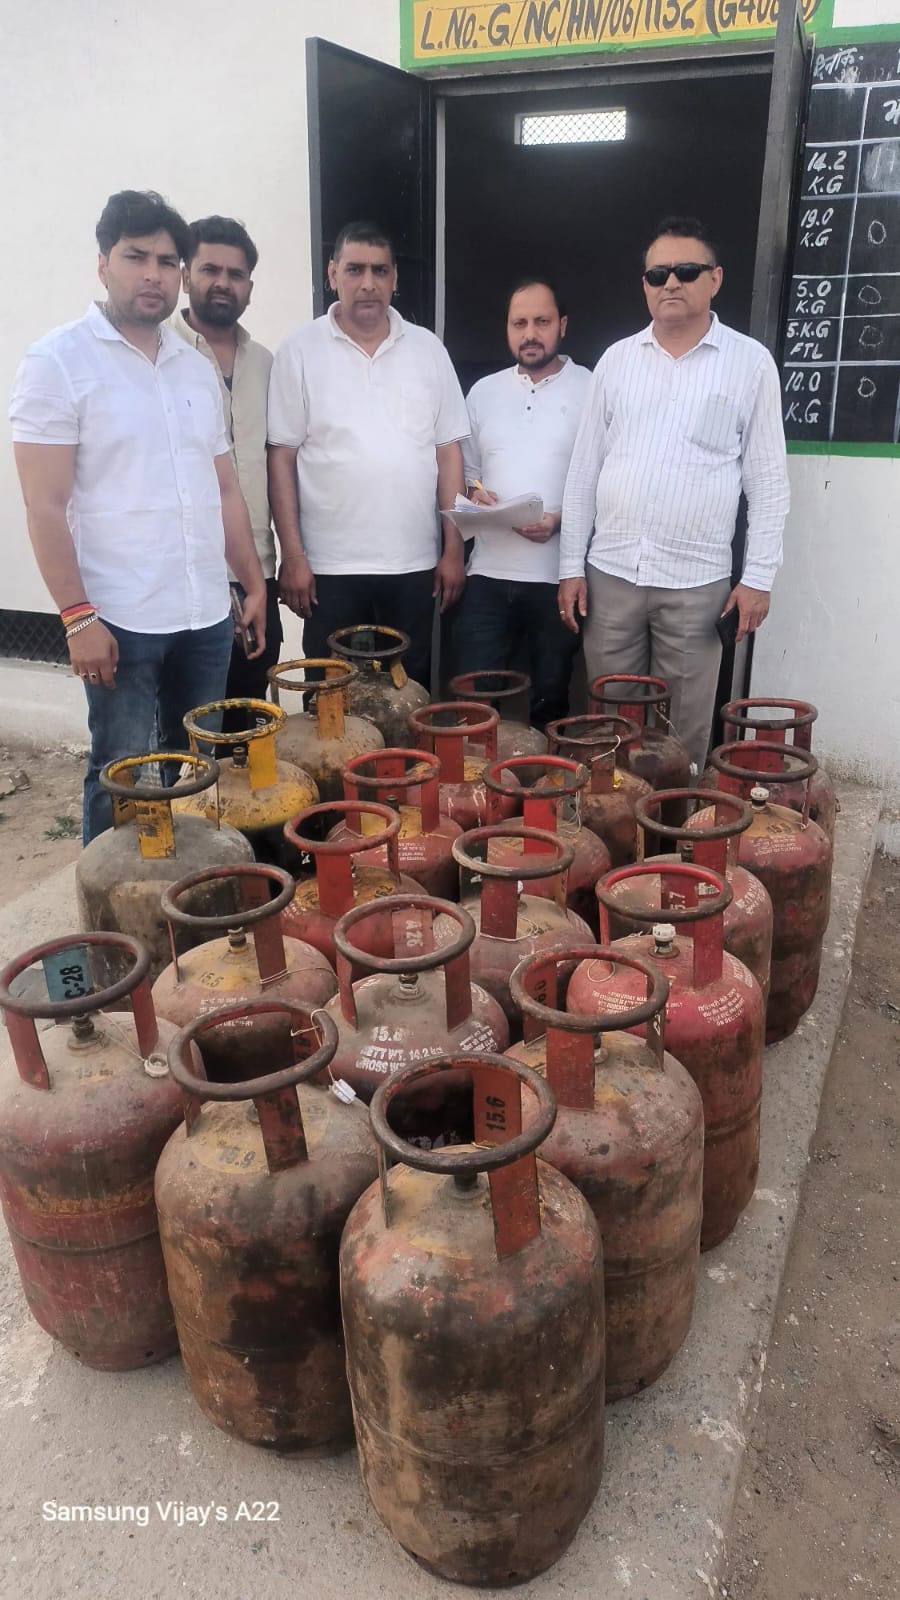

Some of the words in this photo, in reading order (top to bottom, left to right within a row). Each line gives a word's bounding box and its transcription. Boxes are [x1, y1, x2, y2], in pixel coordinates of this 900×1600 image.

[807, 150, 847, 172] 14.2
[808, 174, 844, 195] K.G
[800, 207, 834, 228] 19.0
[800, 228, 833, 247] K.G
[796, 280, 832, 298] 5.0
[795, 299, 826, 314] K.G
[790, 342, 824, 360] FTL
[785, 371, 821, 392] 10.0
[785, 399, 822, 424] K.G
[485, 1095, 507, 1133] 15.6
